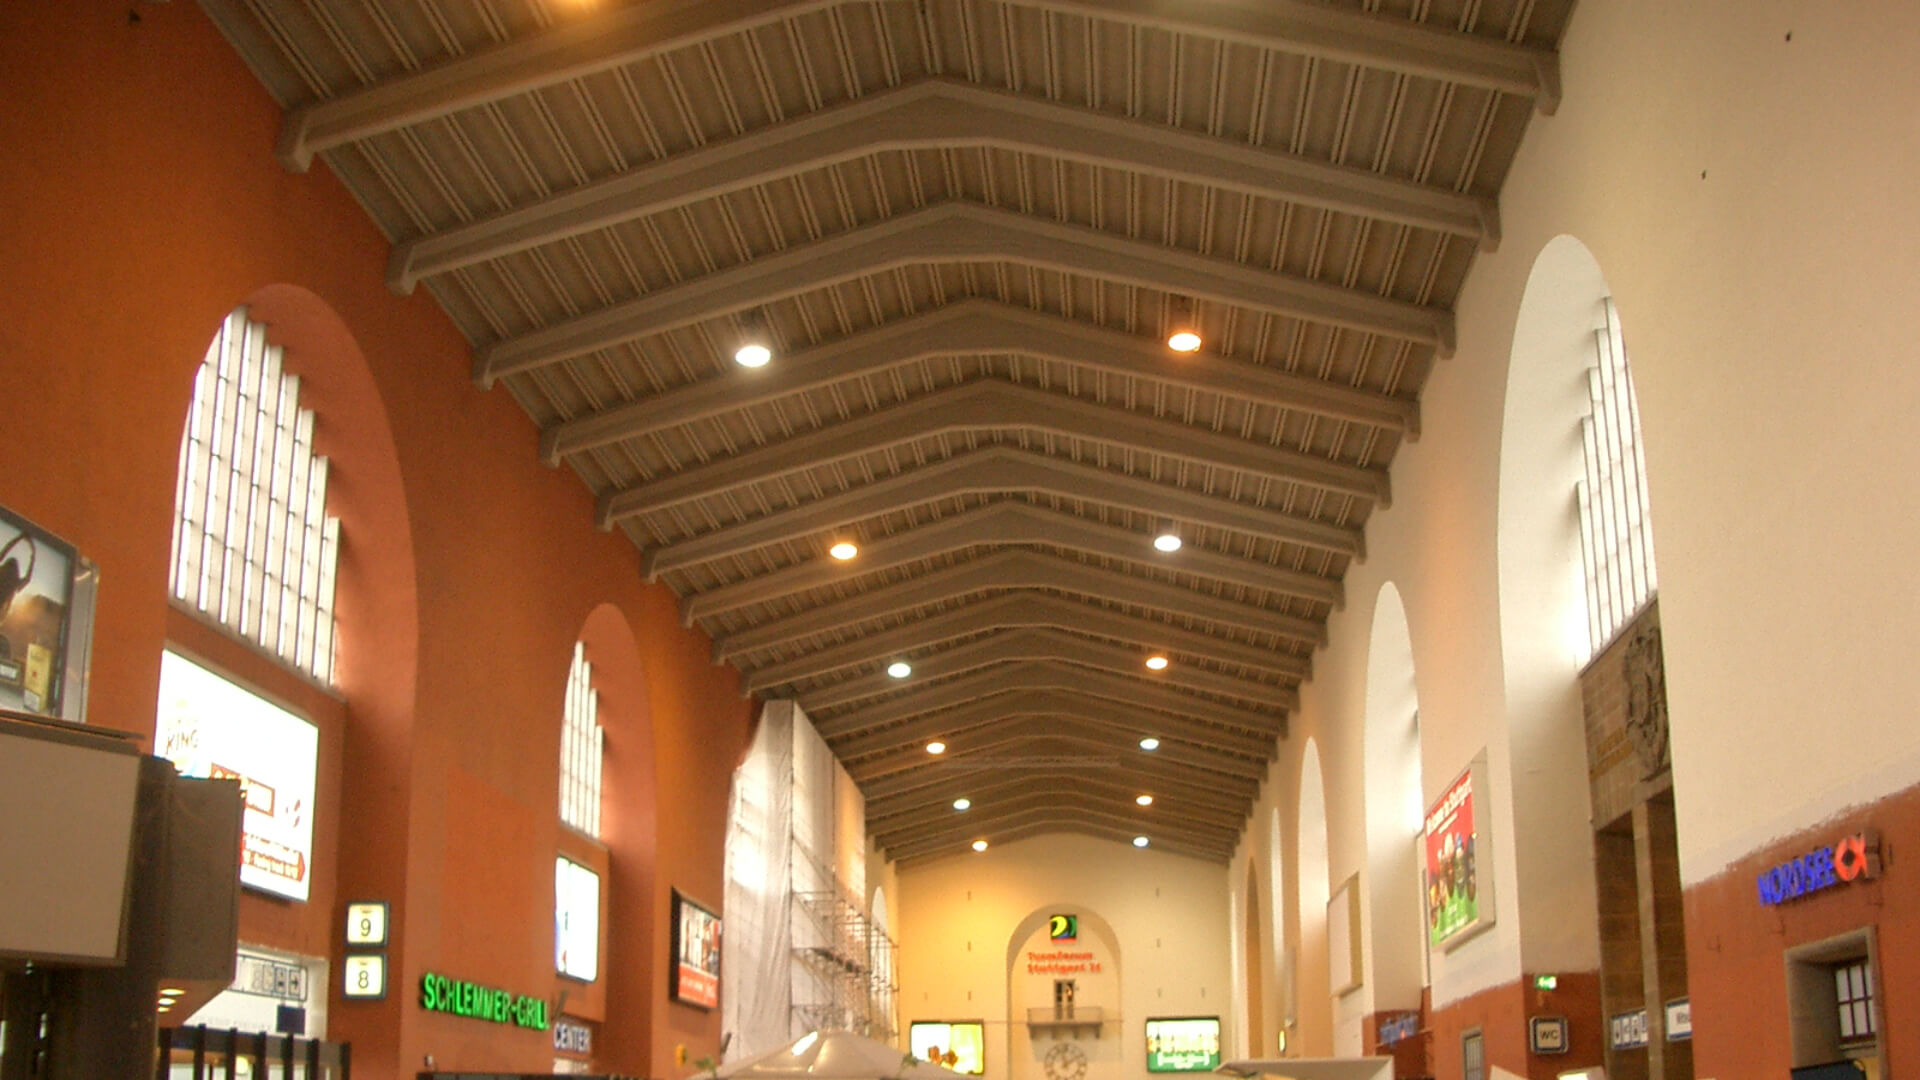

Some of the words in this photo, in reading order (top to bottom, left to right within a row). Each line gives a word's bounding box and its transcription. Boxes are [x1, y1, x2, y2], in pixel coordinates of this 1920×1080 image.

[165, 729, 198, 756] KING
[1757, 846, 1836, 907] NORDSEE
[360, 918, 371, 937] 9
[358, 970, 369, 989] 8
[424, 972, 550, 1031] SCHLEMMER-GRILL
[553, 1022, 591, 1053] CENTER
[1540, 1030, 1558, 1041] WC
